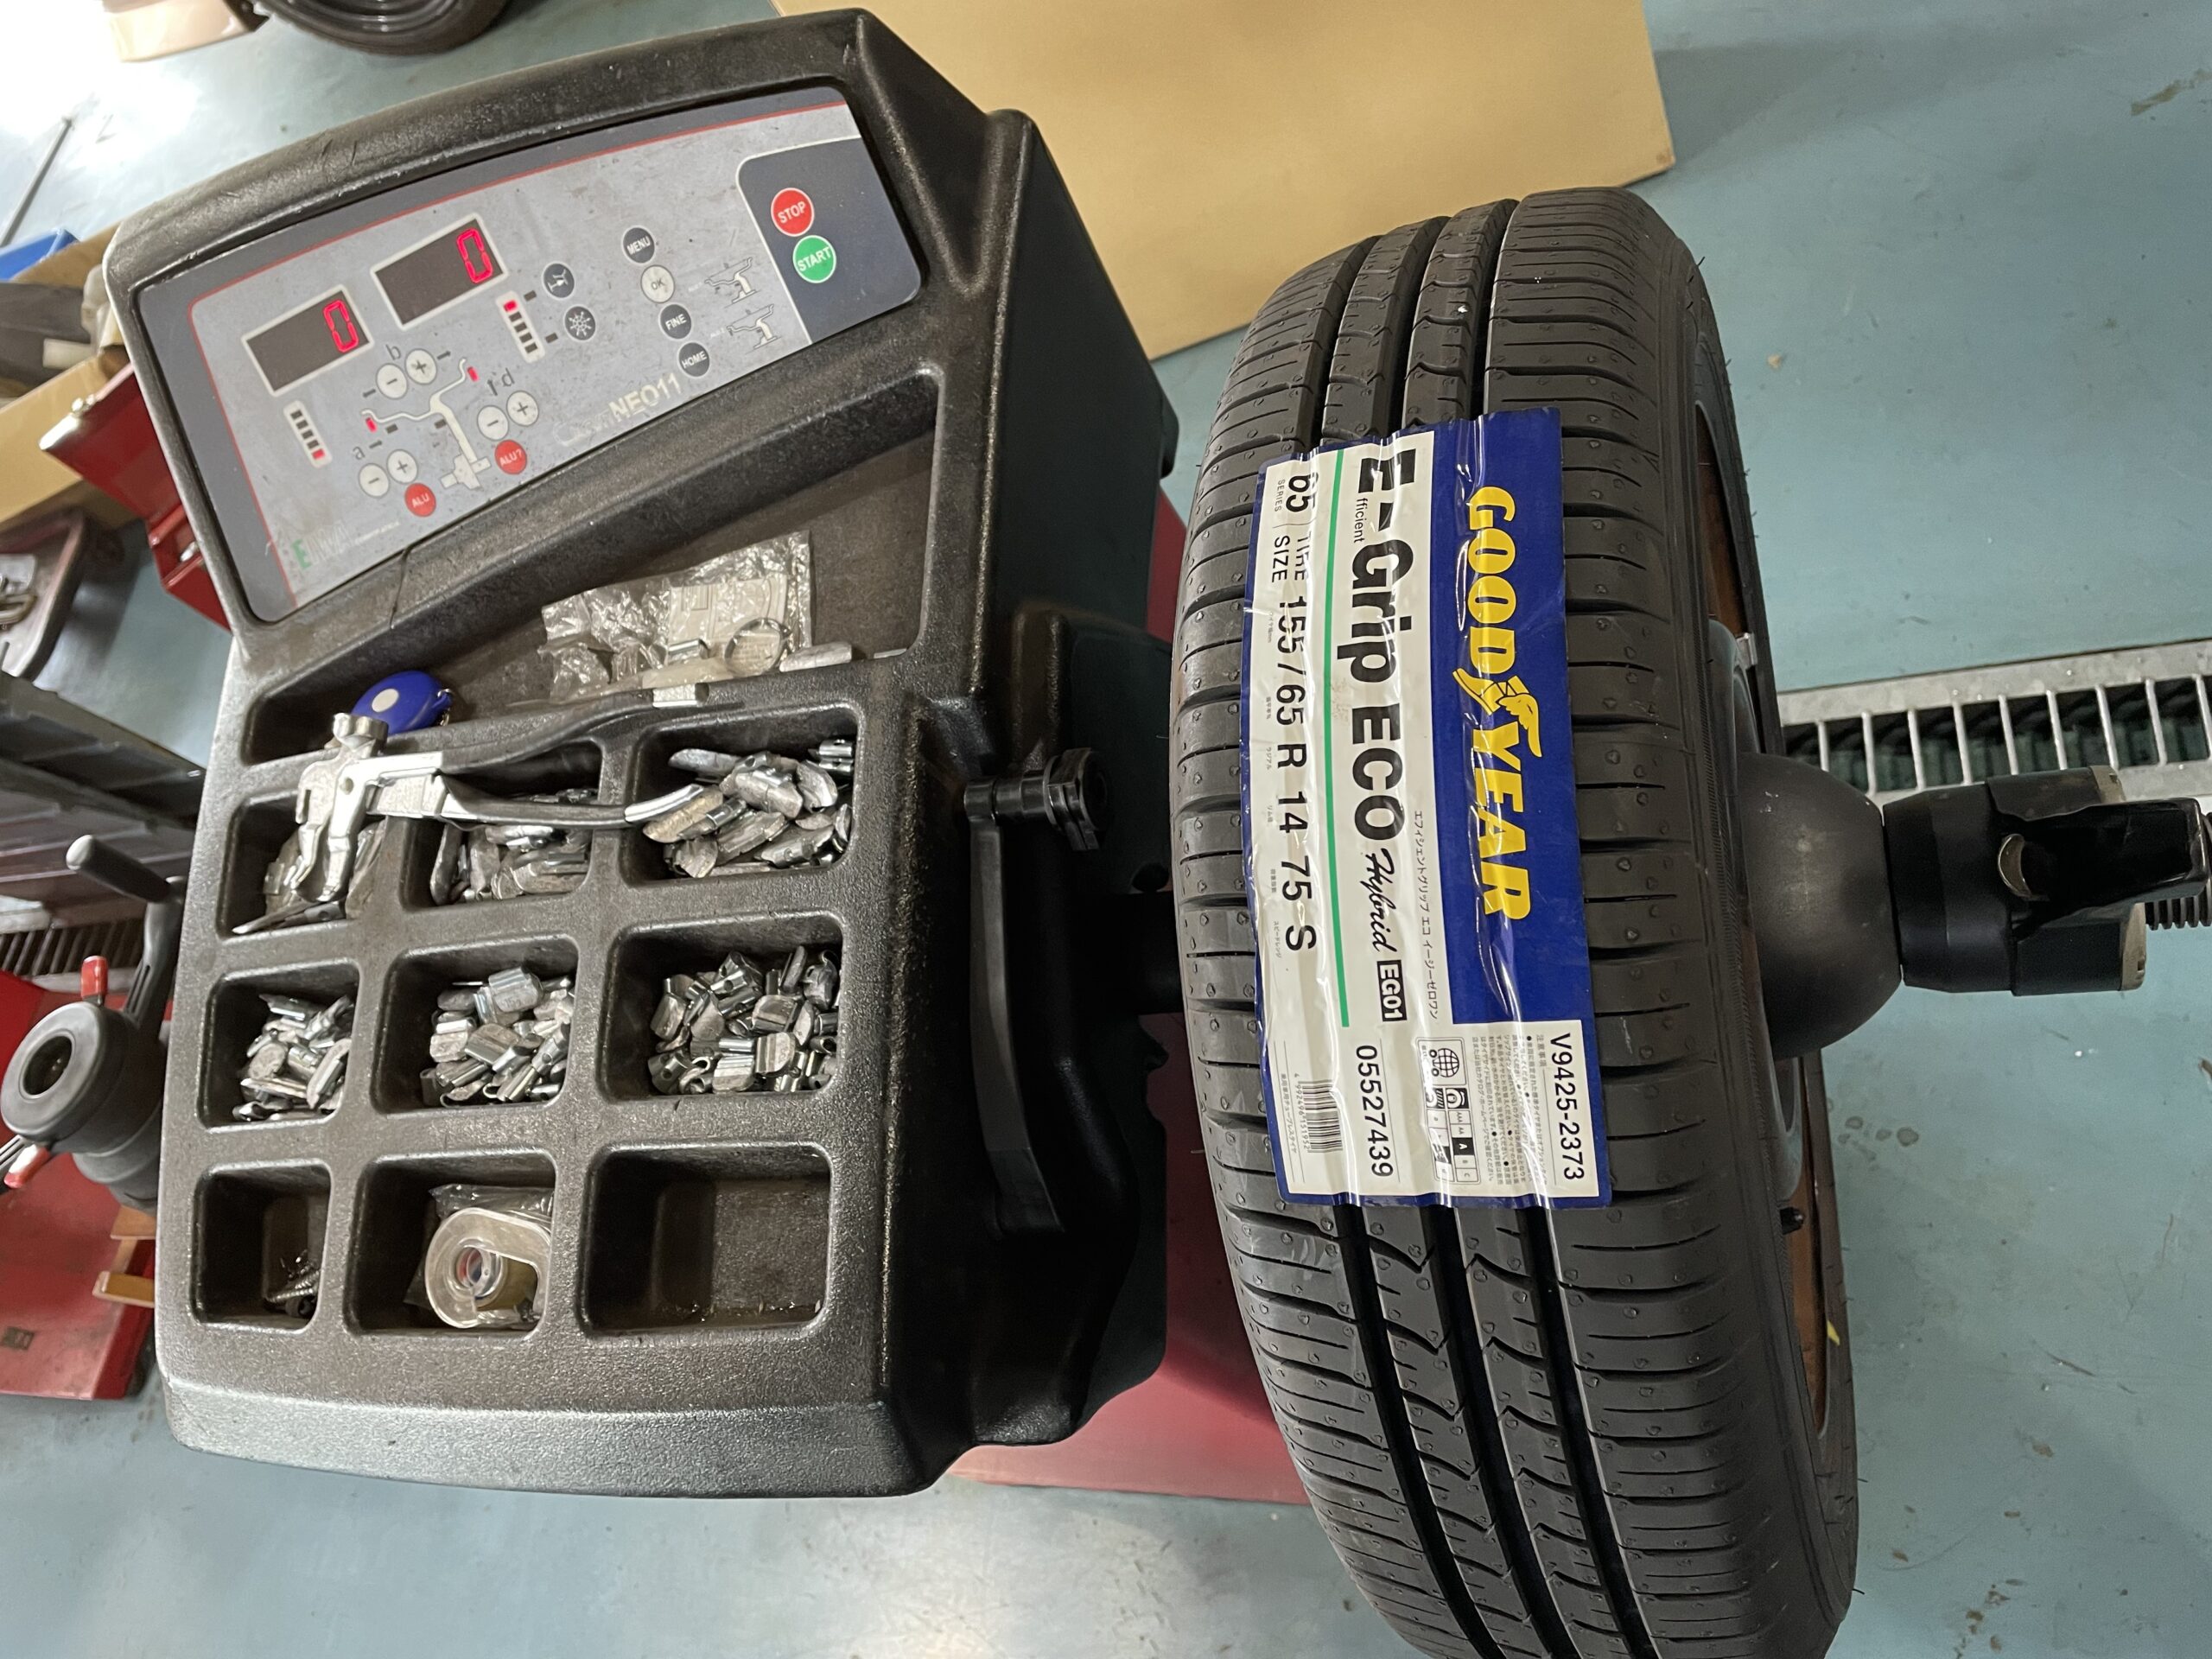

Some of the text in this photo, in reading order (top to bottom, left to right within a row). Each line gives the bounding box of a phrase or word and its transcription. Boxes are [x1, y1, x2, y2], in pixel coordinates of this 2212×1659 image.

[777, 200, 807, 224] STOP
[456, 227, 493, 283] 0
[626, 235, 652, 256] MENU
[797, 246, 832, 272] START
[650, 278, 666, 291] OK
[322, 299, 359, 353] 0
[664, 313, 688, 331] FINE
[385, 344, 402, 360] b
[681, 350, 708, 370] HOME
[501, 367, 516, 387] d
[352, 445, 366, 461] a
[410, 493, 431, 509] ALU
[1274, 479, 1286, 512] SERIES
[1285, 472, 1319, 512] 65
[1353, 498, 1369, 543] fficient
[1271, 535, 1291, 583] SIZE
[1294, 530, 1313, 582] TIRE
[1467, 485, 1531, 920] GOODYEAR
[1277, 743, 1307, 769] R
[1351, 702, 1406, 841] ECO
[1278, 791, 1309, 834] 14
[1281, 855, 1313, 901] 75
[1359, 847, 1398, 952] Hybrid
[1414, 810, 1439, 1020] エフィシェントグリップ エコ イージーゼロワン
[1285, 925, 1317, 951] S
[1378, 962, 1406, 1021] EG01
[1355, 1045, 1395, 1178] 05527439
[1549, 1033, 1586, 1180] V9425-2373
